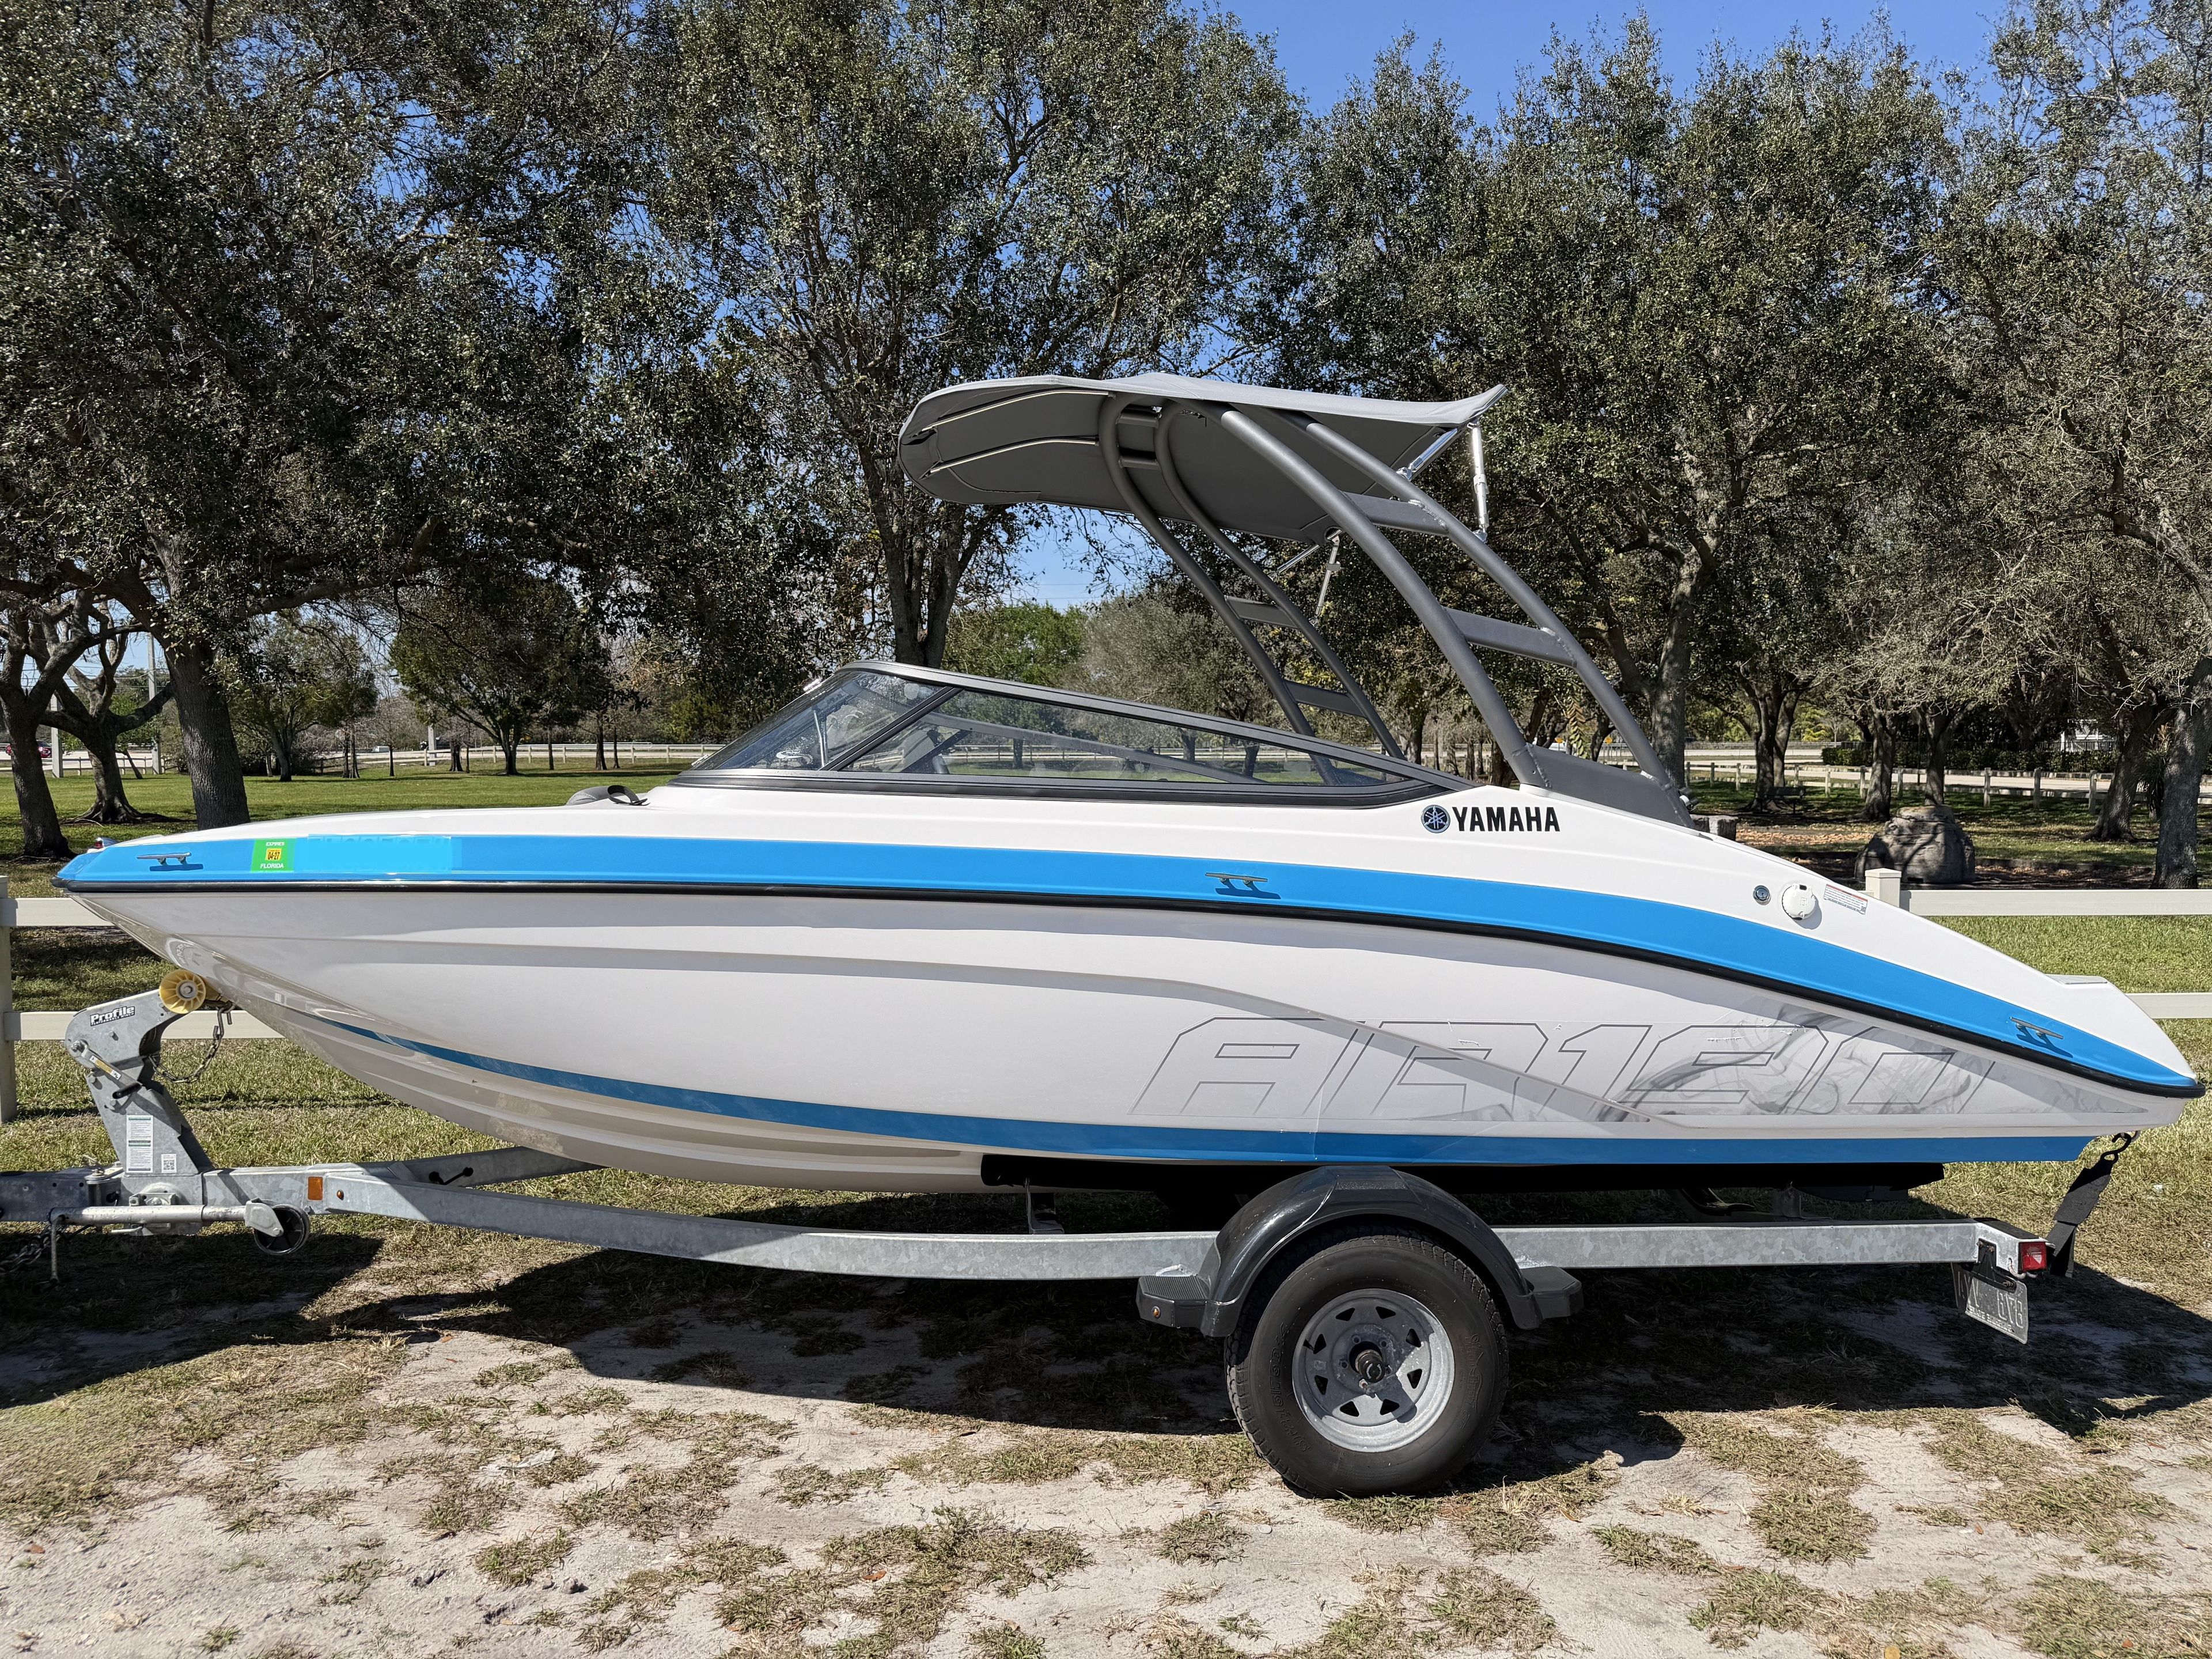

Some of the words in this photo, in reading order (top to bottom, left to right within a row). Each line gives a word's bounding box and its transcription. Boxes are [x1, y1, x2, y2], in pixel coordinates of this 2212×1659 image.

[1452, 806, 1560, 832] YAMAHA
[267, 851, 281, 860] 04-27
[90, 1006, 135, 1023] Profile
